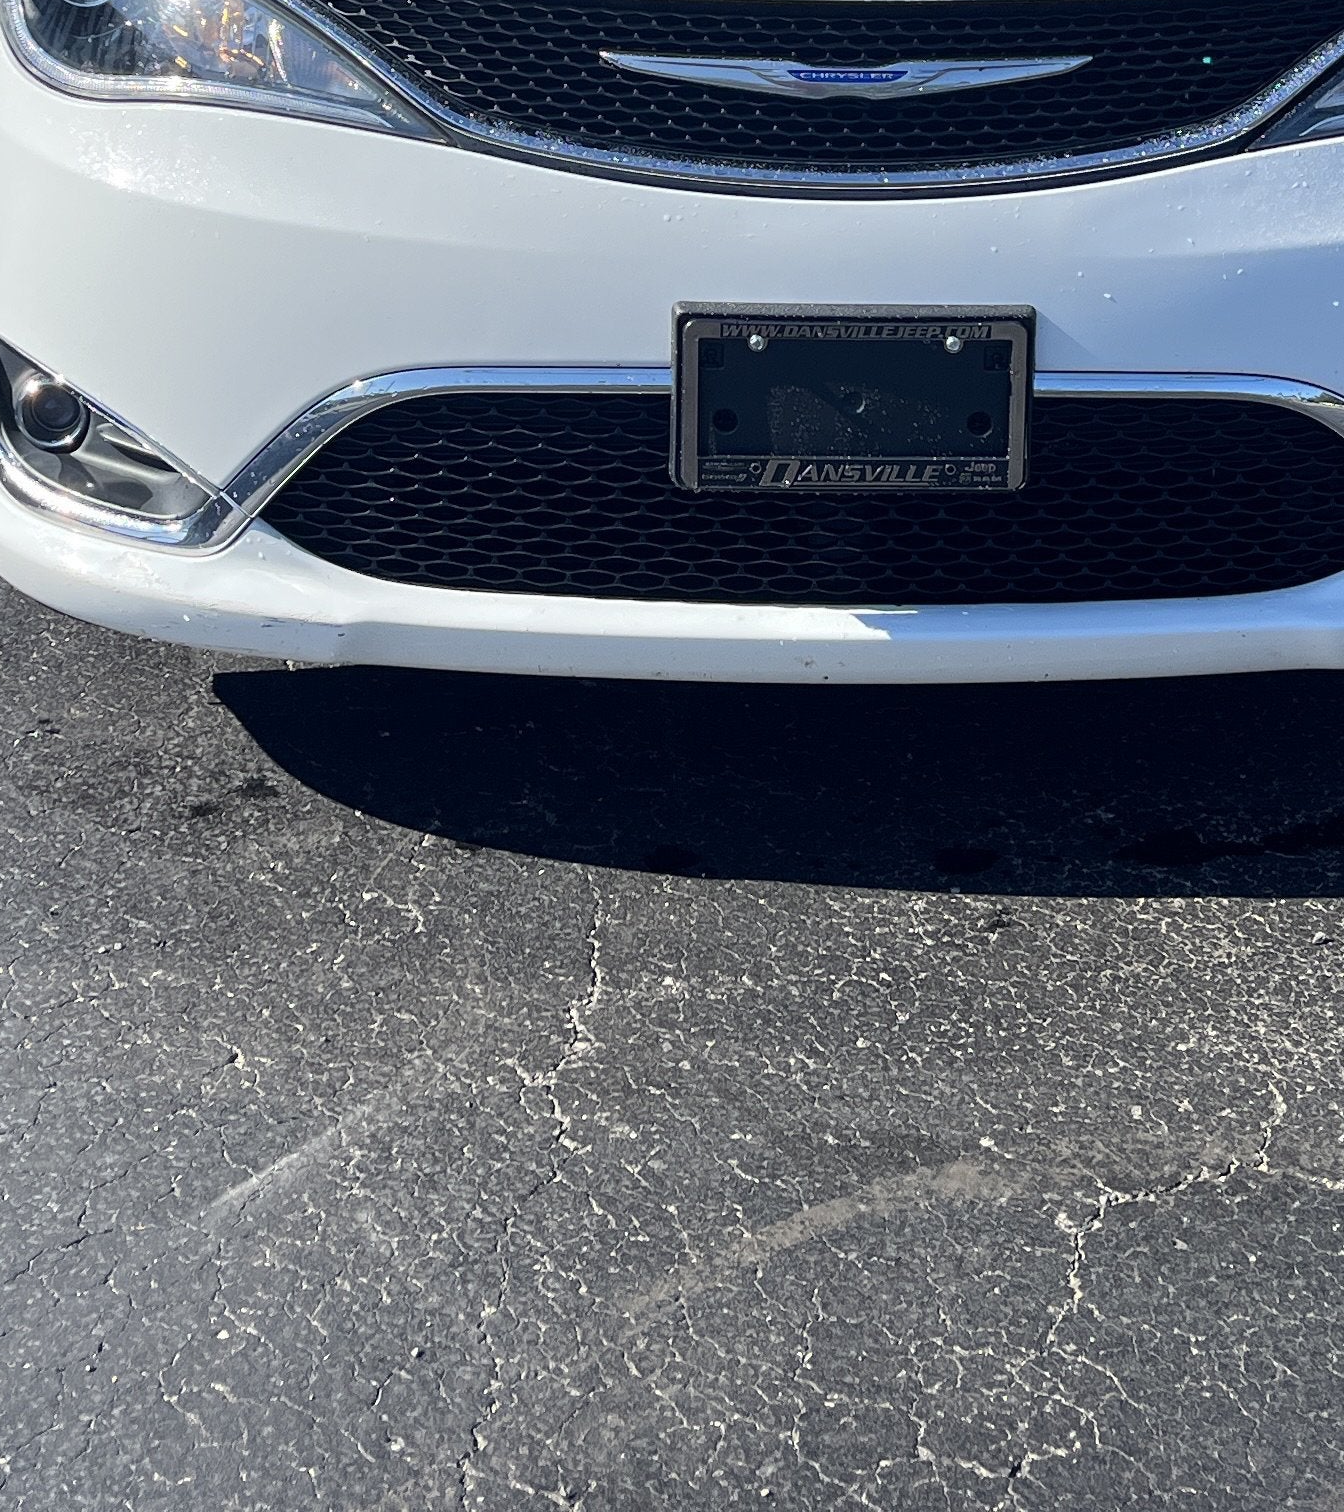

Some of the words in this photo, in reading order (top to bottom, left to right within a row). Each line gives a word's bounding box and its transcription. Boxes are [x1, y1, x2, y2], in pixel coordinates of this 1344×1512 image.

[799, 72, 894, 80] CHRYSLER
[721, 324, 991, 339] WWW.DANSVILLEJEEP.COM
[758, 459, 943, 488] DANSVILLE
